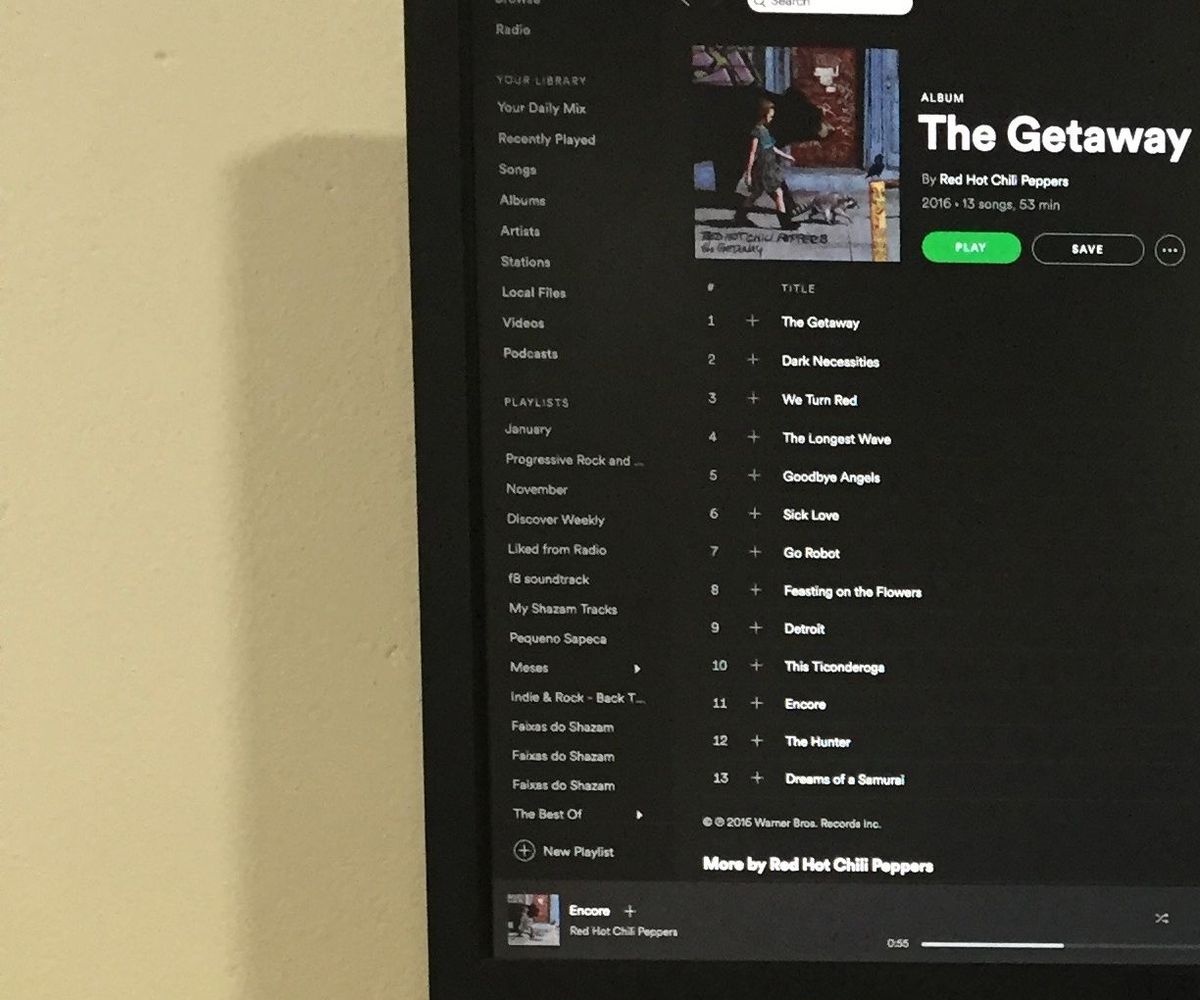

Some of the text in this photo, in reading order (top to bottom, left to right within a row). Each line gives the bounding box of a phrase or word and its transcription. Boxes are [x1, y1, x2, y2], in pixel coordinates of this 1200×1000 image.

[495, 23, 531, 36] Radio
[496, 75, 586, 86] YOUR LIBRARY
[920, 92, 964, 104] ALBUM
[497, 101, 587, 117] Your Daily Mix
[498, 132, 596, 148] Recently Played
[917, 113, 1193, 163] The Getaway
[498, 162, 537, 179] Songs
[921, 172, 1070, 189] By Red Hot Chili Peppers
[499, 193, 546, 207] Albums
[921, 196, 1061, 213] 2016 13 songs, 53 min
[500, 224, 541, 237] Artists
[955, 241, 986, 253] PLAY
[1071, 243, 1104, 255] SAVE
[500, 255, 551, 268] Stations
[502, 286, 567, 299] Local Files
[781, 283, 815, 294] TITLE
[502, 316, 545, 329] Videos
[781, 315, 861, 332] The Getaway
[503, 347, 559, 360] Podcasts
[781, 354, 880, 369] Dark Necessities
[504, 397, 569, 409] PLAYLISTS
[781, 393, 858, 407] We Turn Red
[504, 423, 552, 438] January
[782, 431, 892, 447] The Longest Wave
[505, 452, 631, 468] Progressive Rock and
[782, 470, 881, 486] Goodbye Angels
[506, 482, 569, 496] November
[506, 512, 606, 528] Discover Weekly
[782, 508, 840, 522] Sick Love
[507, 543, 608, 556] Liked from Radio
[783, 546, 841, 560] Go Robot
[508, 572, 590, 585] f8 soundtrack
[783, 584, 923, 600] Feasting on the Flowers
[509, 602, 618, 616] My Shazam Tracks
[784, 622, 826, 635] Detroit
[509, 631, 608, 647] Pequeno Sapeca
[510, 661, 549, 674] Meses
[712, 659, 728, 671] 10
[784, 660, 885, 676] This Ticonderoga
[712, 697, 728, 709] 11
[784, 697, 827, 711] Encore
[712, 734, 728, 747] 12
[784, 735, 852, 748] The Hunter
[713, 772, 729, 784] 13
[785, 772, 905, 786] Dreams of a Samurai
[512, 807, 583, 820] The Best Of
[543, 845, 615, 860] New Playlist
[702, 855, 934, 876] More by Red Hot Chili Peppers
[568, 904, 611, 917] Encore
[569, 925, 678, 939] Red Hot Chili Peppers
